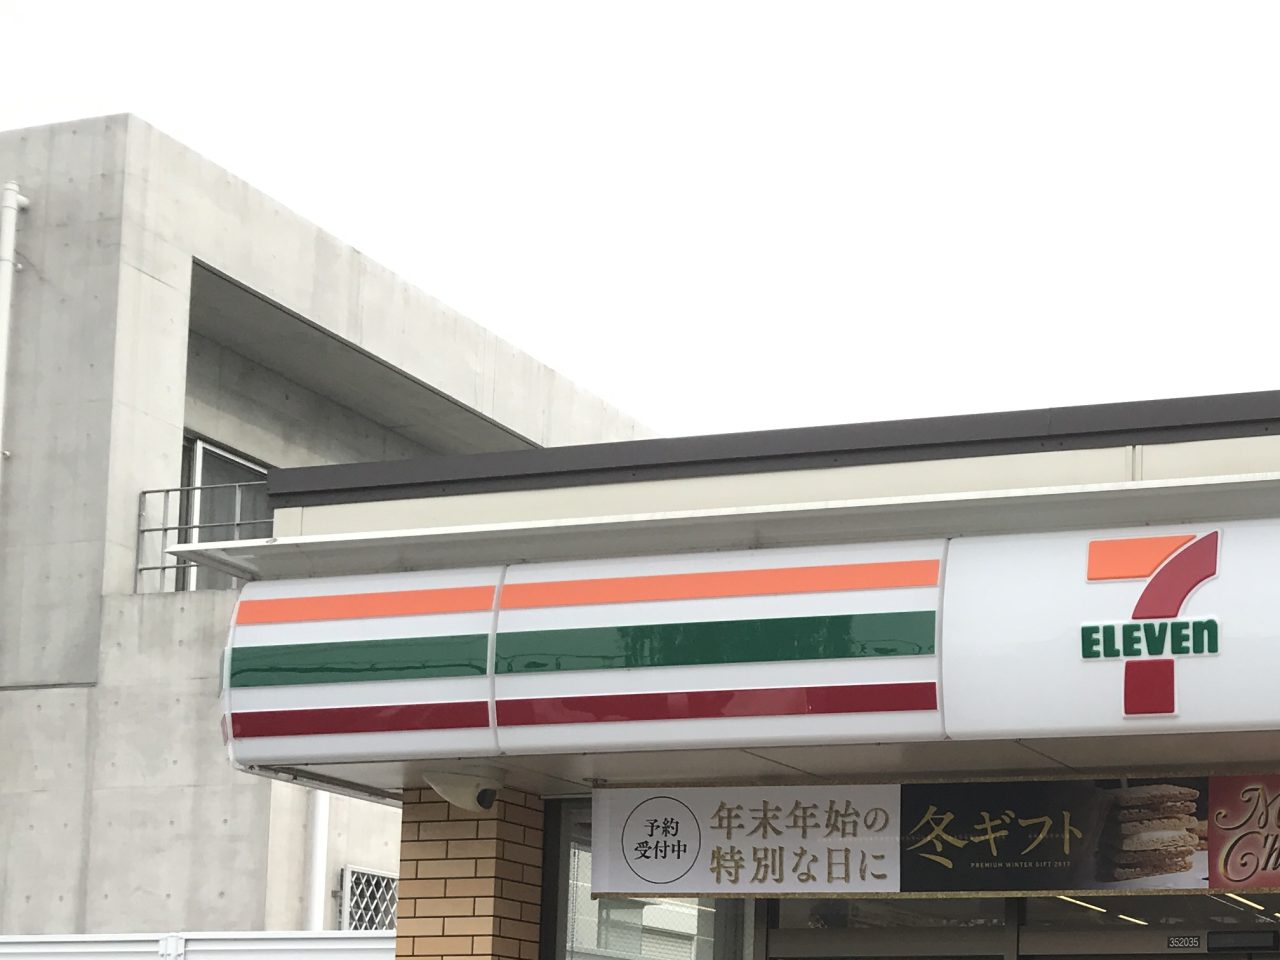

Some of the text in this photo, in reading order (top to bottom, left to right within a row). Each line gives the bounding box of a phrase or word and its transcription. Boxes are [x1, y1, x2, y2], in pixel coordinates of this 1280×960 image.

[644, 818, 679, 837] 予約
[709, 800, 889, 840] 年末年始の
[634, 840, 687, 860] 受付中
[906, 805, 1083, 869] 冬ギフト
[709, 845, 888, 885] 特別な日に
[1168, 937, 1199, 947] 352035
